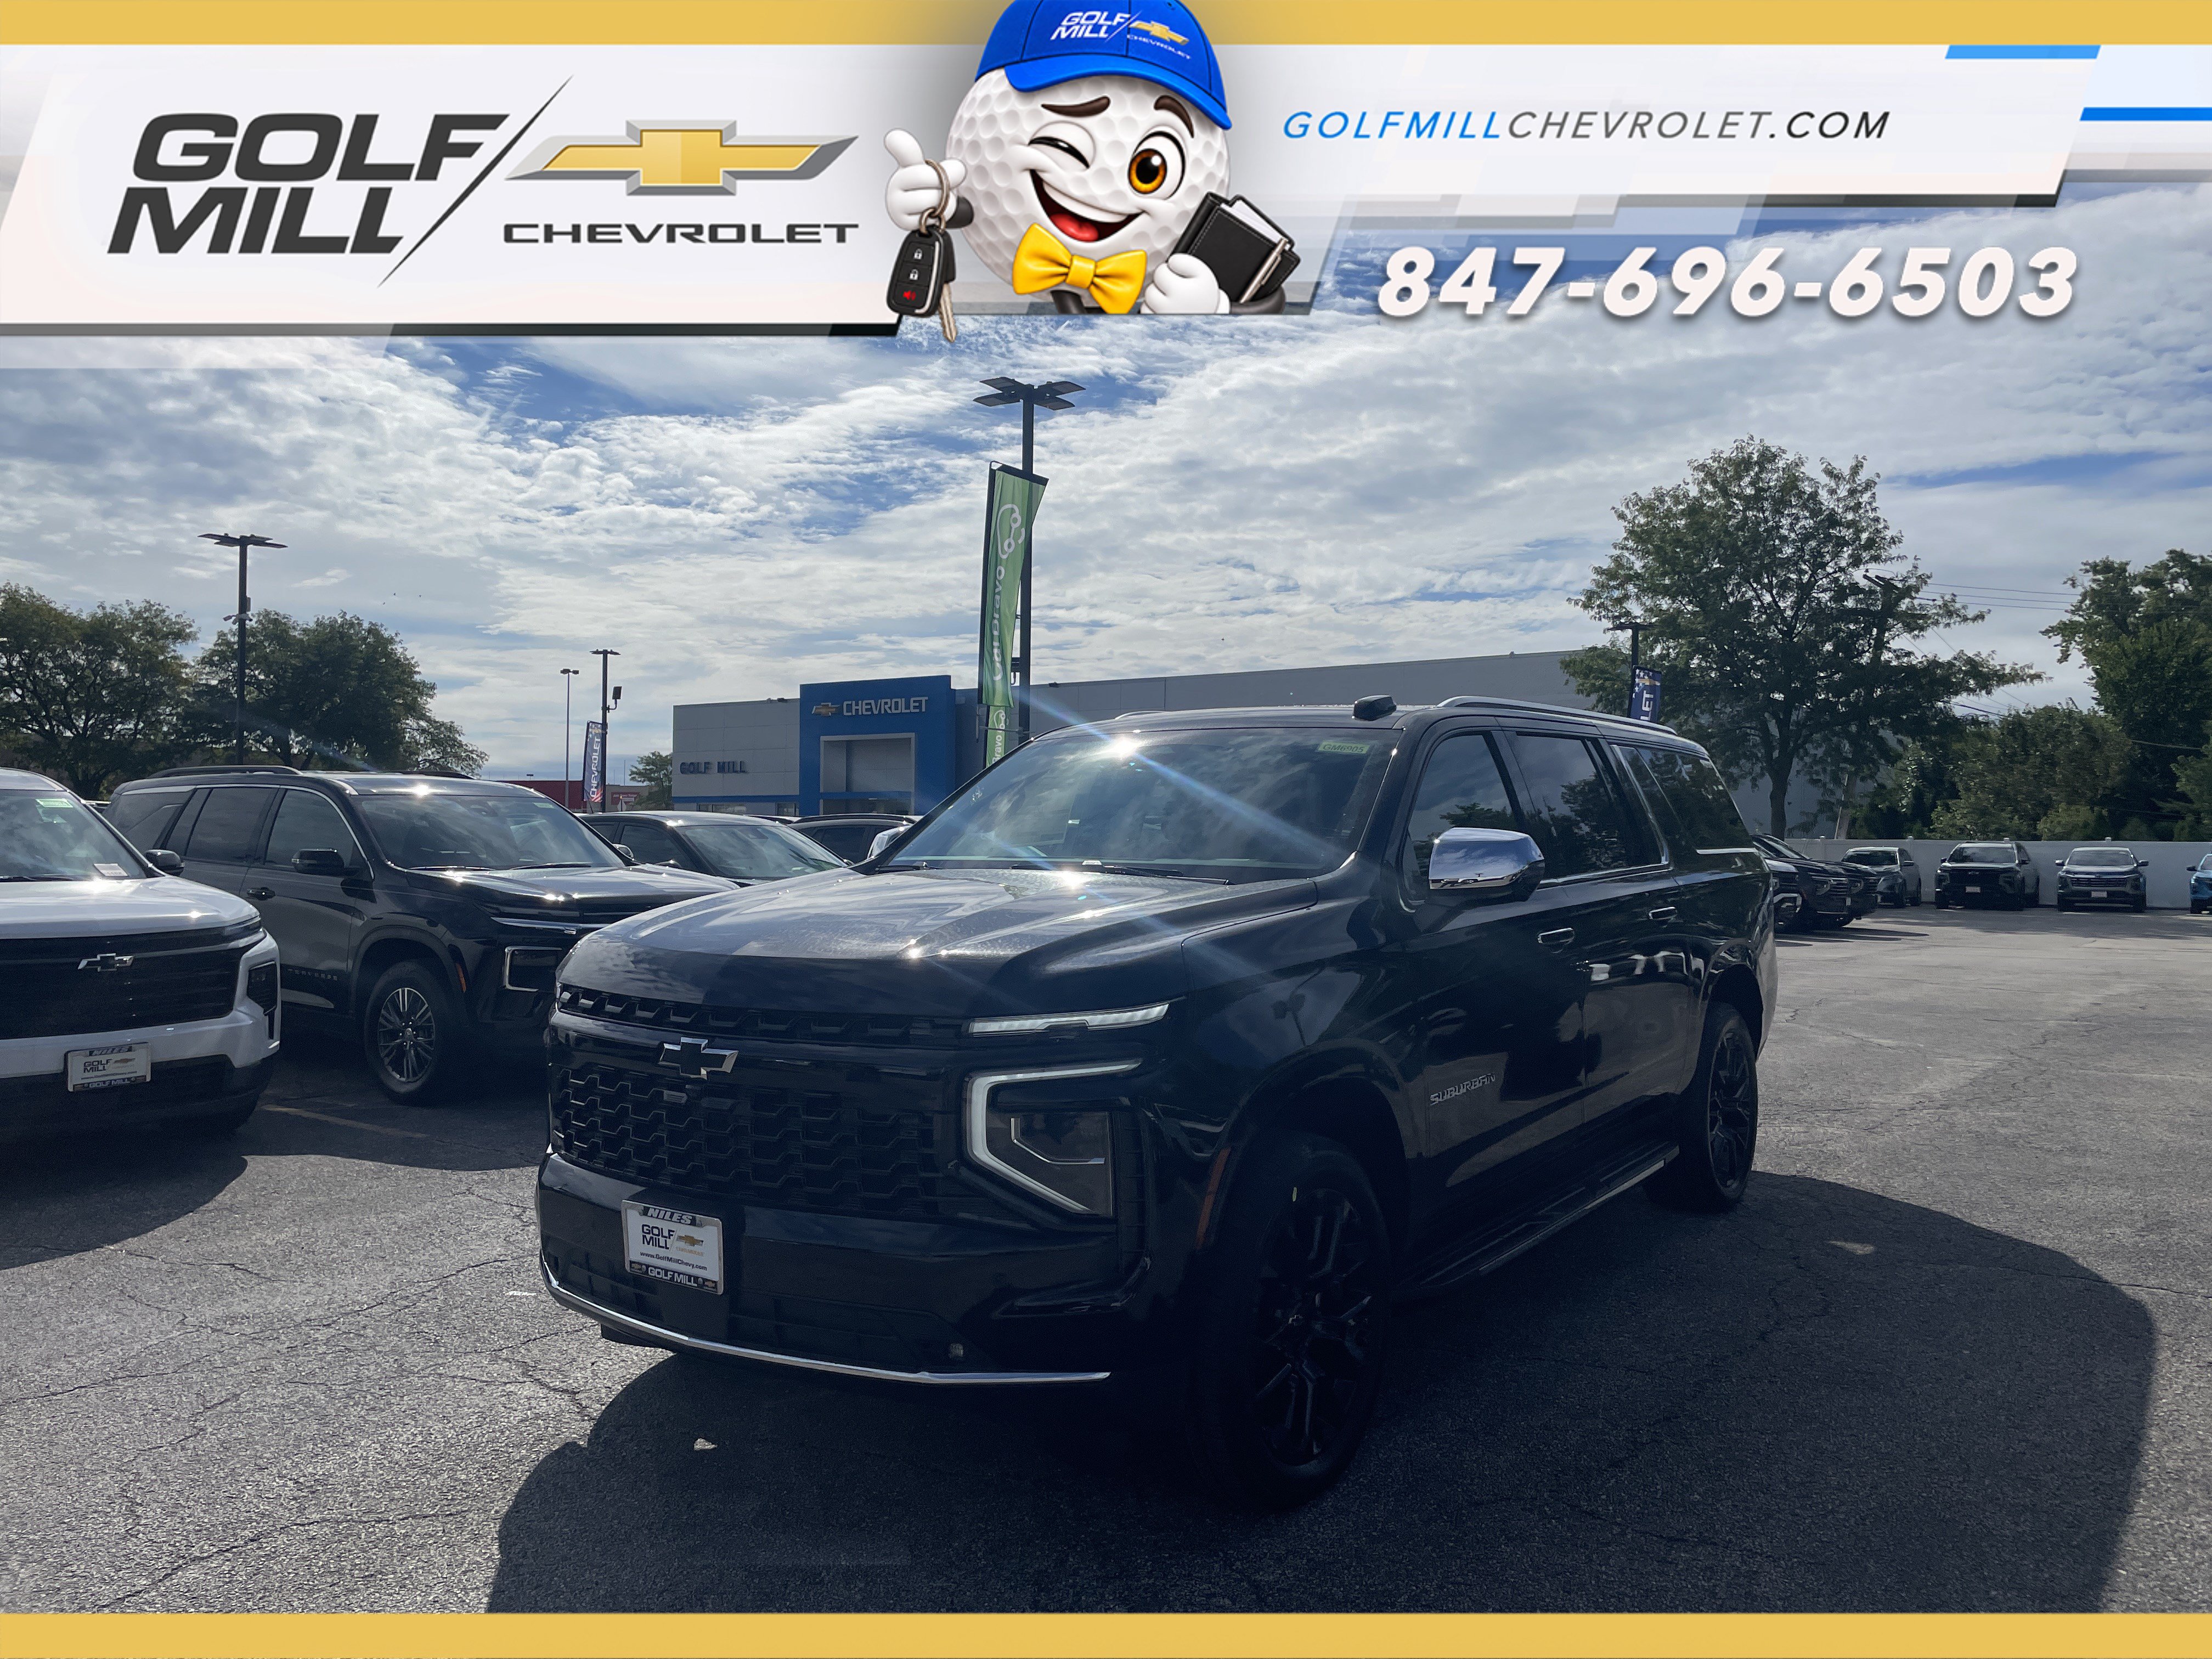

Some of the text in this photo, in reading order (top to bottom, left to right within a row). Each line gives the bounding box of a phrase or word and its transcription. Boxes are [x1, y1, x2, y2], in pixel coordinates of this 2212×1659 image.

[843, 696, 929, 716] CHEVROLET
[590, 736, 601, 798] CHEVROLET
[680, 760, 747, 775] GOLF MILL
[83, 1059, 112, 1068] GOLF
[1430, 1073, 1496, 1105] SUBURBAN
[647, 1207, 693, 1224] NILES
[641, 1224, 675, 1240] GOLF
[642, 1234, 670, 1250] MILL
[640, 1251, 707, 1271] www.GolfMillChevy.com
[648, 1266, 698, 1287] GOLF MILL
